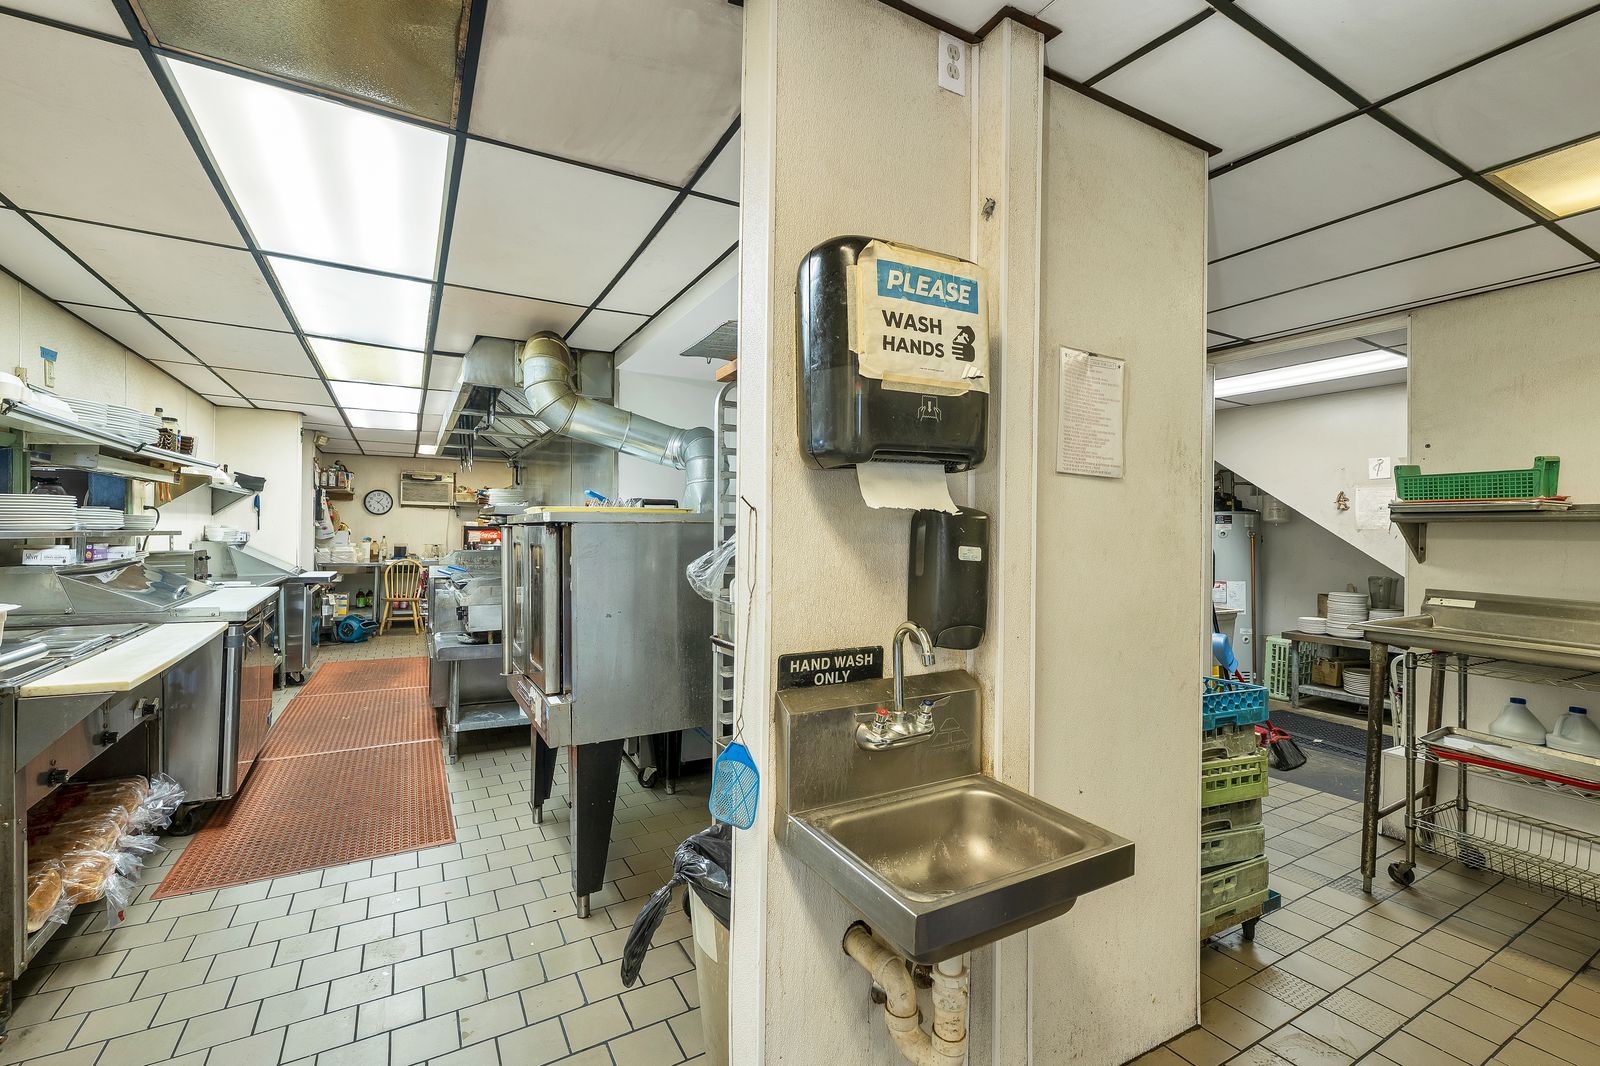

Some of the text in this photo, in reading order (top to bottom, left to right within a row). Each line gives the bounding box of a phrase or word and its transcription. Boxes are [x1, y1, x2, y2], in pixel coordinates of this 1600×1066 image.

[886, 269, 972, 305] PLEASE
[881, 309, 943, 335] WASH
[882, 335, 945, 358] HANDS
[790, 653, 873, 673] HAND WASH
[814, 670, 851, 686] ONLY
